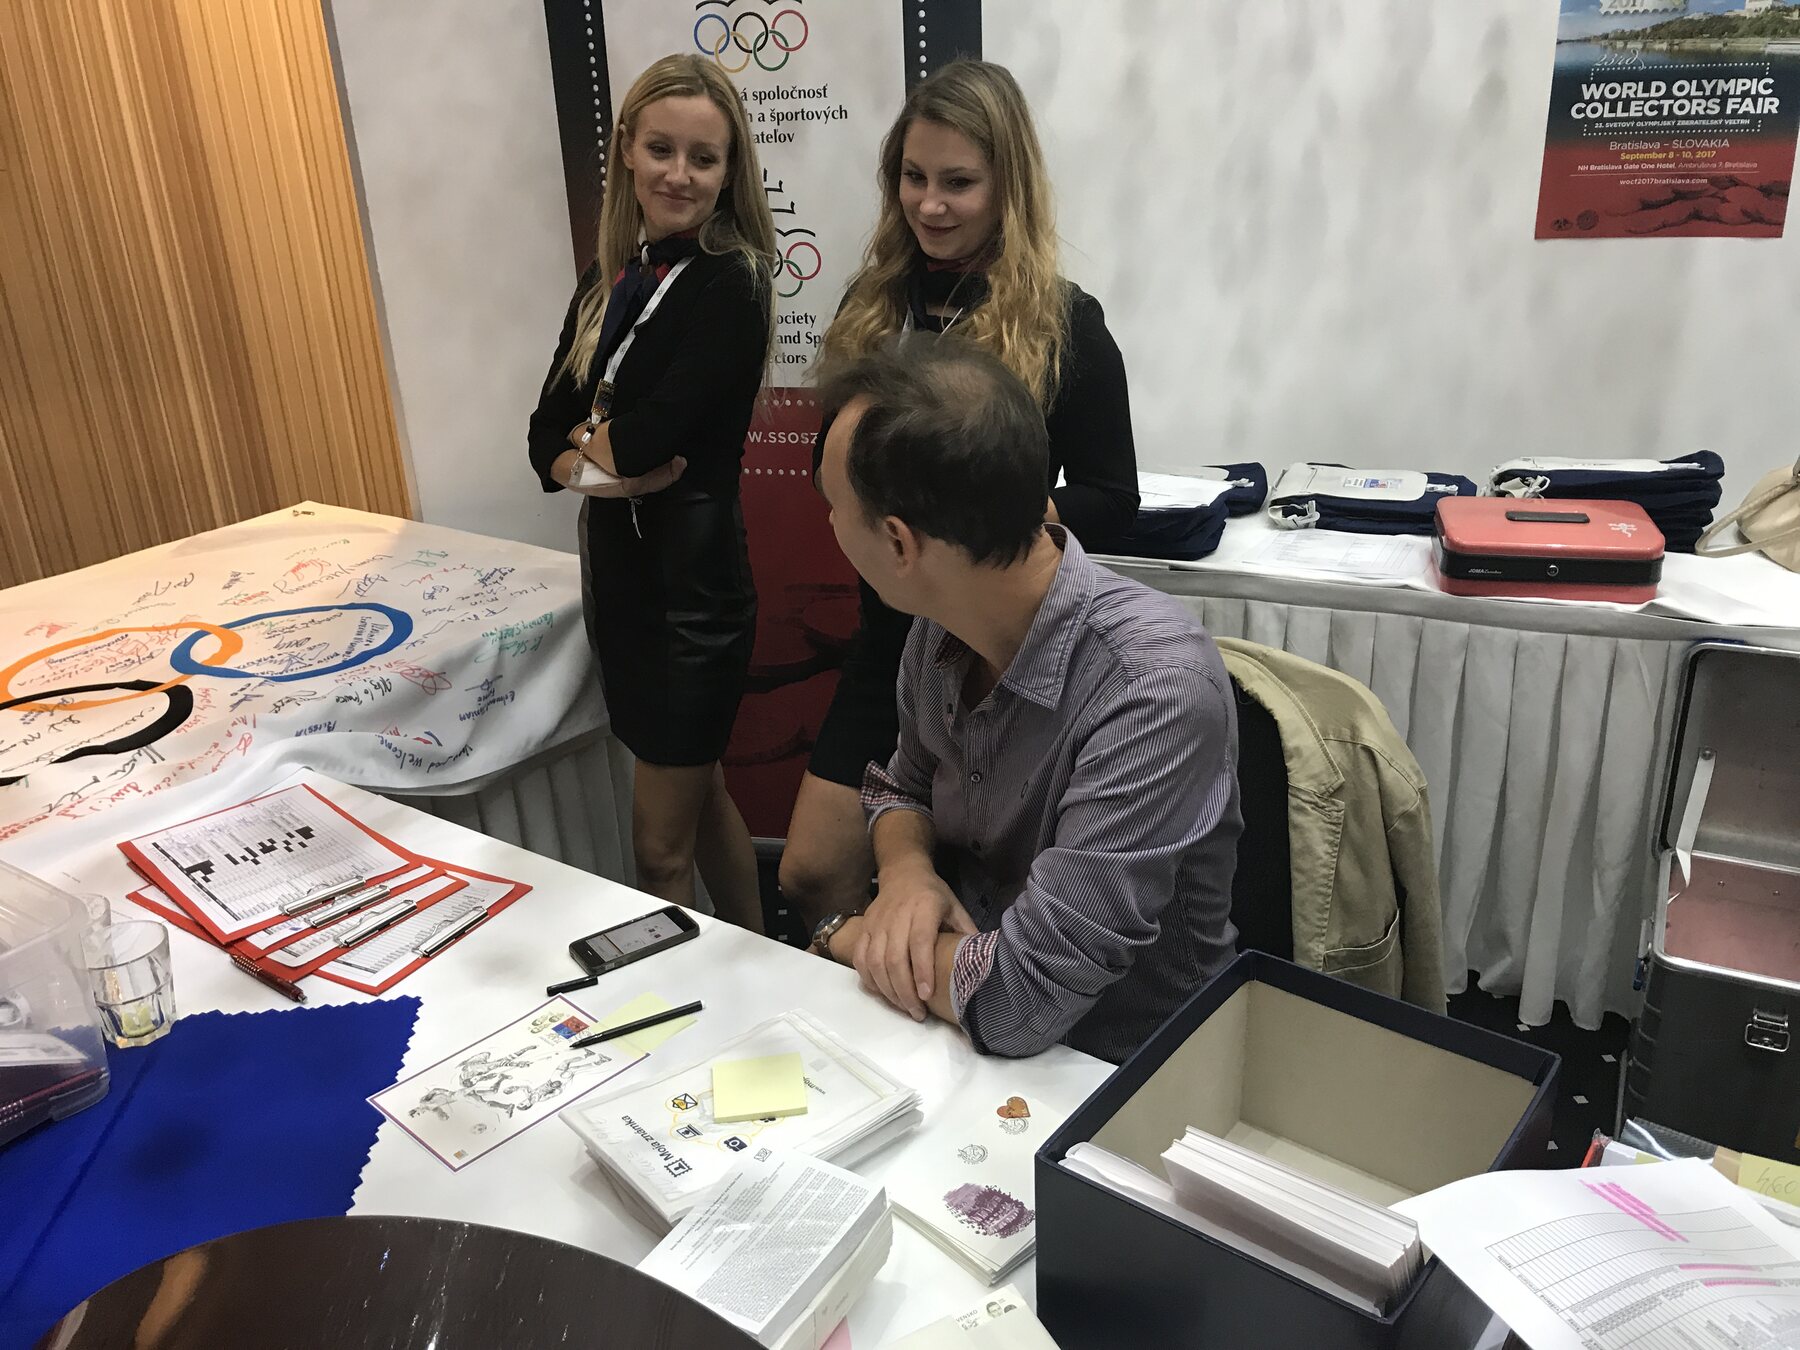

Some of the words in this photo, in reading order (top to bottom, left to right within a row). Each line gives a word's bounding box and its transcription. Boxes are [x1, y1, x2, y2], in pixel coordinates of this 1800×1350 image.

[752, 83, 828, 105] spoločnosť
[1581, 81, 1667, 100] WORLD
[1672, 78, 1775, 97] OLYMPIC
[757, 112, 766, 122] a
[770, 105, 848, 126] športových
[1570, 98, 1720, 119] COLLECTORS
[1726, 97, 1780, 115] FAIR
[753, 128, 795, 144] ateľov
[1610, 141, 1660, 150] Bratislava
[1672, 139, 1730, 149] SLOVAKIA
[1620, 152, 1667, 160] September
[776, 311, 817, 328] ociety
[776, 331, 801, 344] and
[805, 331, 824, 348] Sp
[747, 431, 819, 445] W.SSOSZ
[621, 1115, 655, 1142] známka
[651, 1141, 674, 1161] Moja
[955, 1309, 979, 1323] VENSKO
